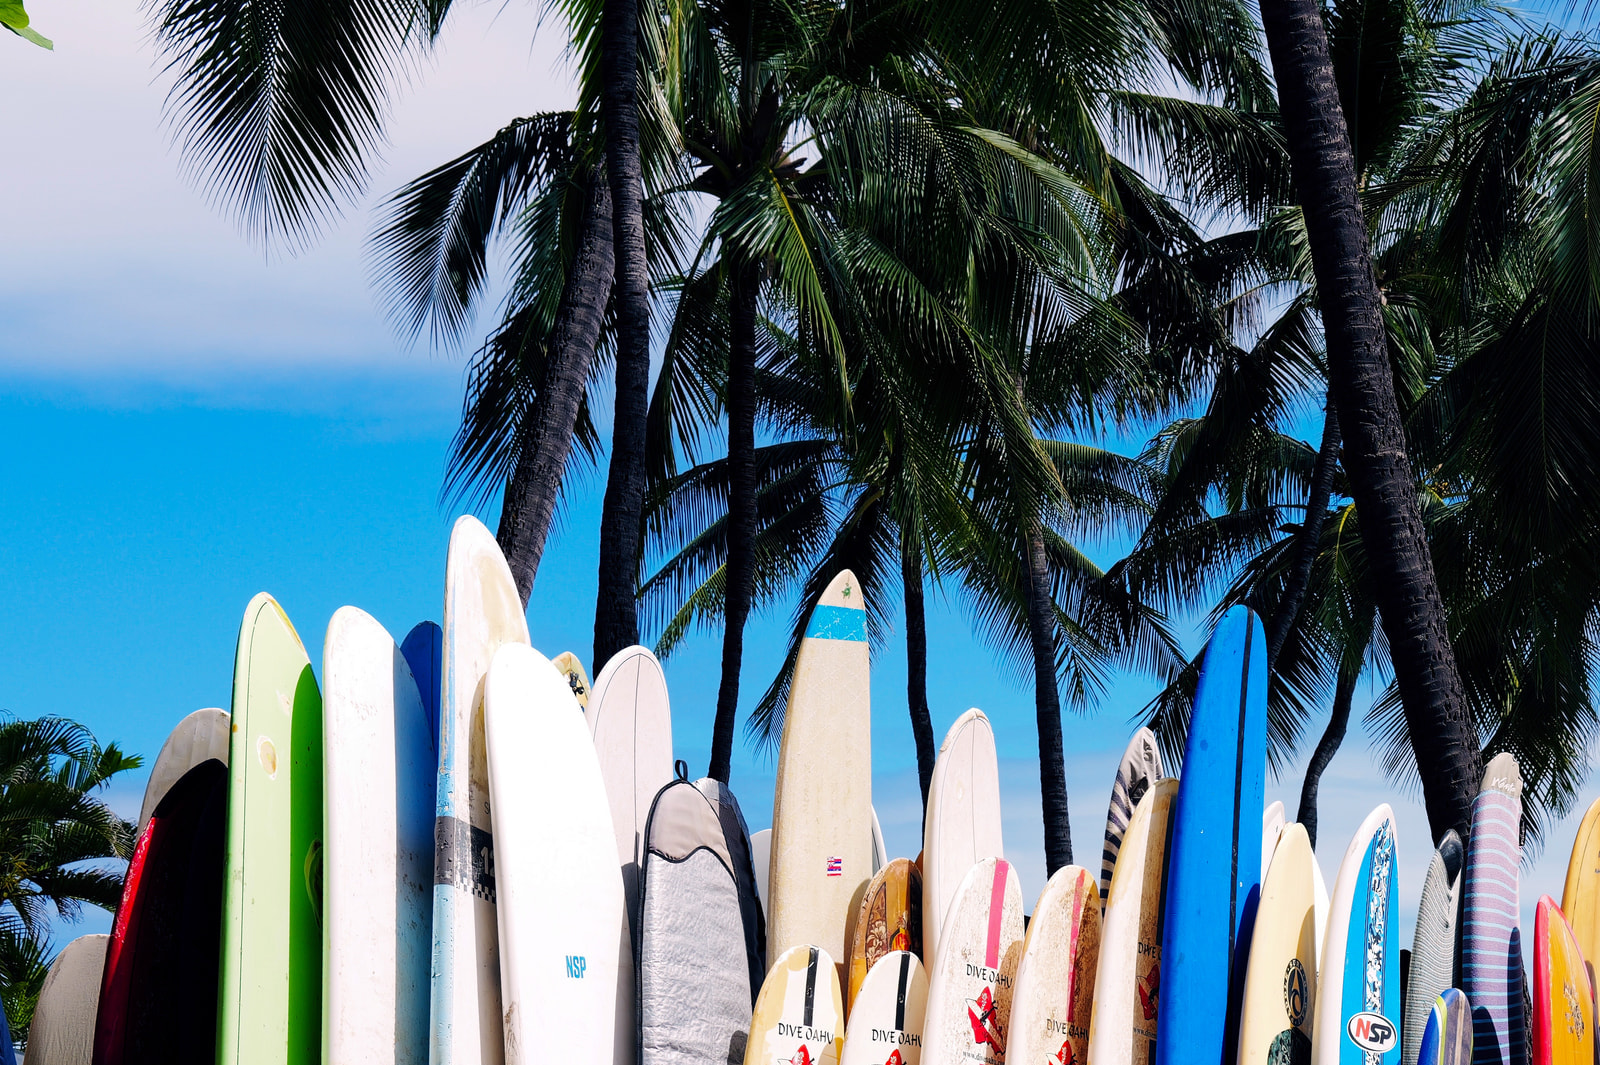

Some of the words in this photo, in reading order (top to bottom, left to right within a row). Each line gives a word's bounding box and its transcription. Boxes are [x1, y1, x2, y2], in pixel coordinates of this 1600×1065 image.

[1138, 942, 1157, 959] DIVE
[565, 955, 587, 979] NSP
[966, 963, 987, 981] DIVE
[988, 971, 1013, 989] OAHU
[778, 1022, 803, 1039] DIVE
[805, 1027, 835, 1045] OAHU
[871, 1029, 896, 1044] DIVE
[1046, 1019, 1067, 1035] DIVE
[1355, 1017, 1392, 1045] NSP
